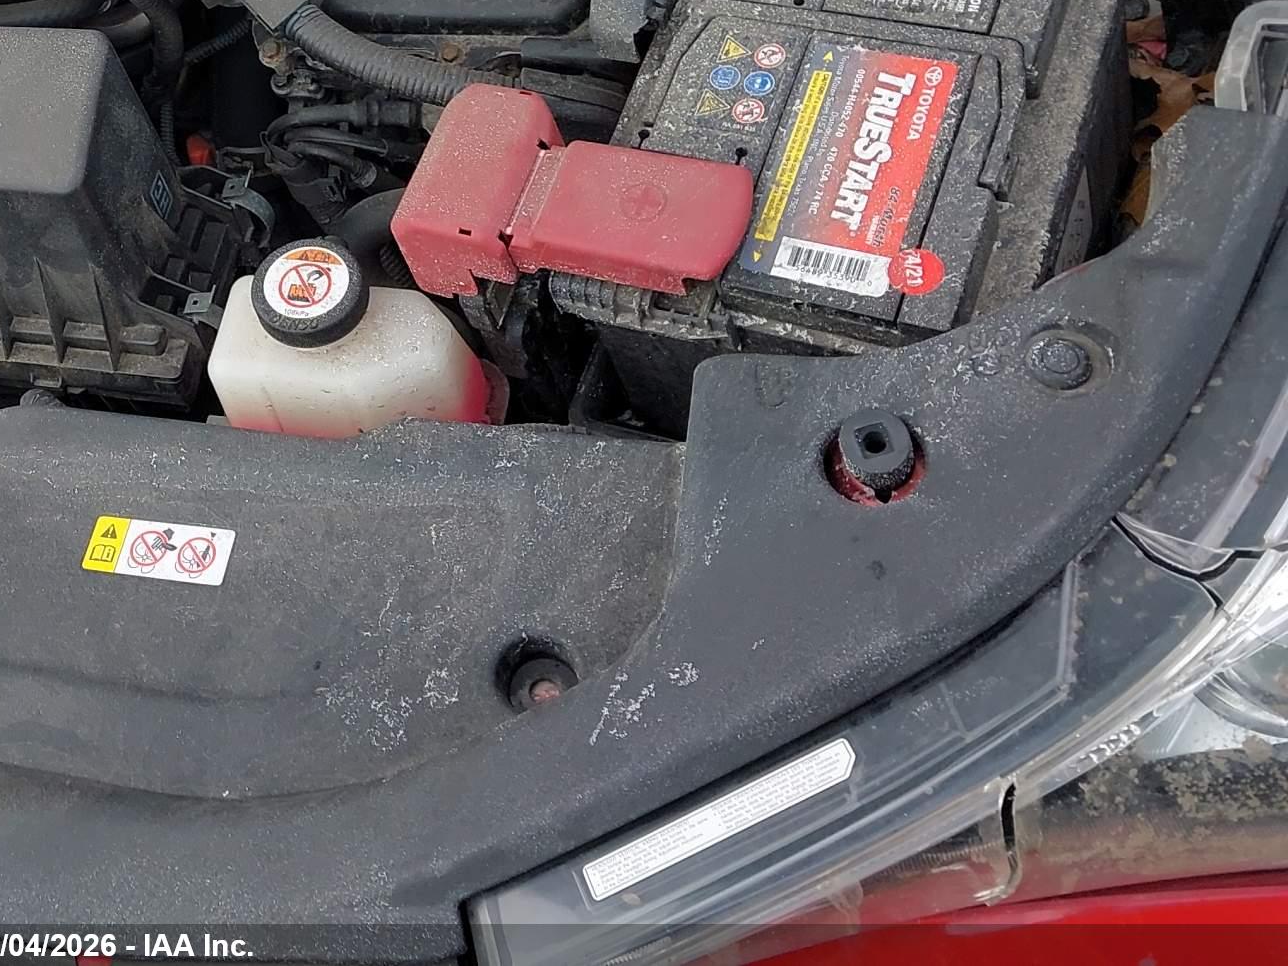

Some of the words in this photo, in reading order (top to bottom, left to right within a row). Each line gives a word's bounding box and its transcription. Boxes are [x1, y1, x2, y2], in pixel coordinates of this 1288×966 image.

[906, 87, 935, 140] TOYOTA
[819, 162, 834, 182] CCA
[268, 315, 320, 332] DENSO
